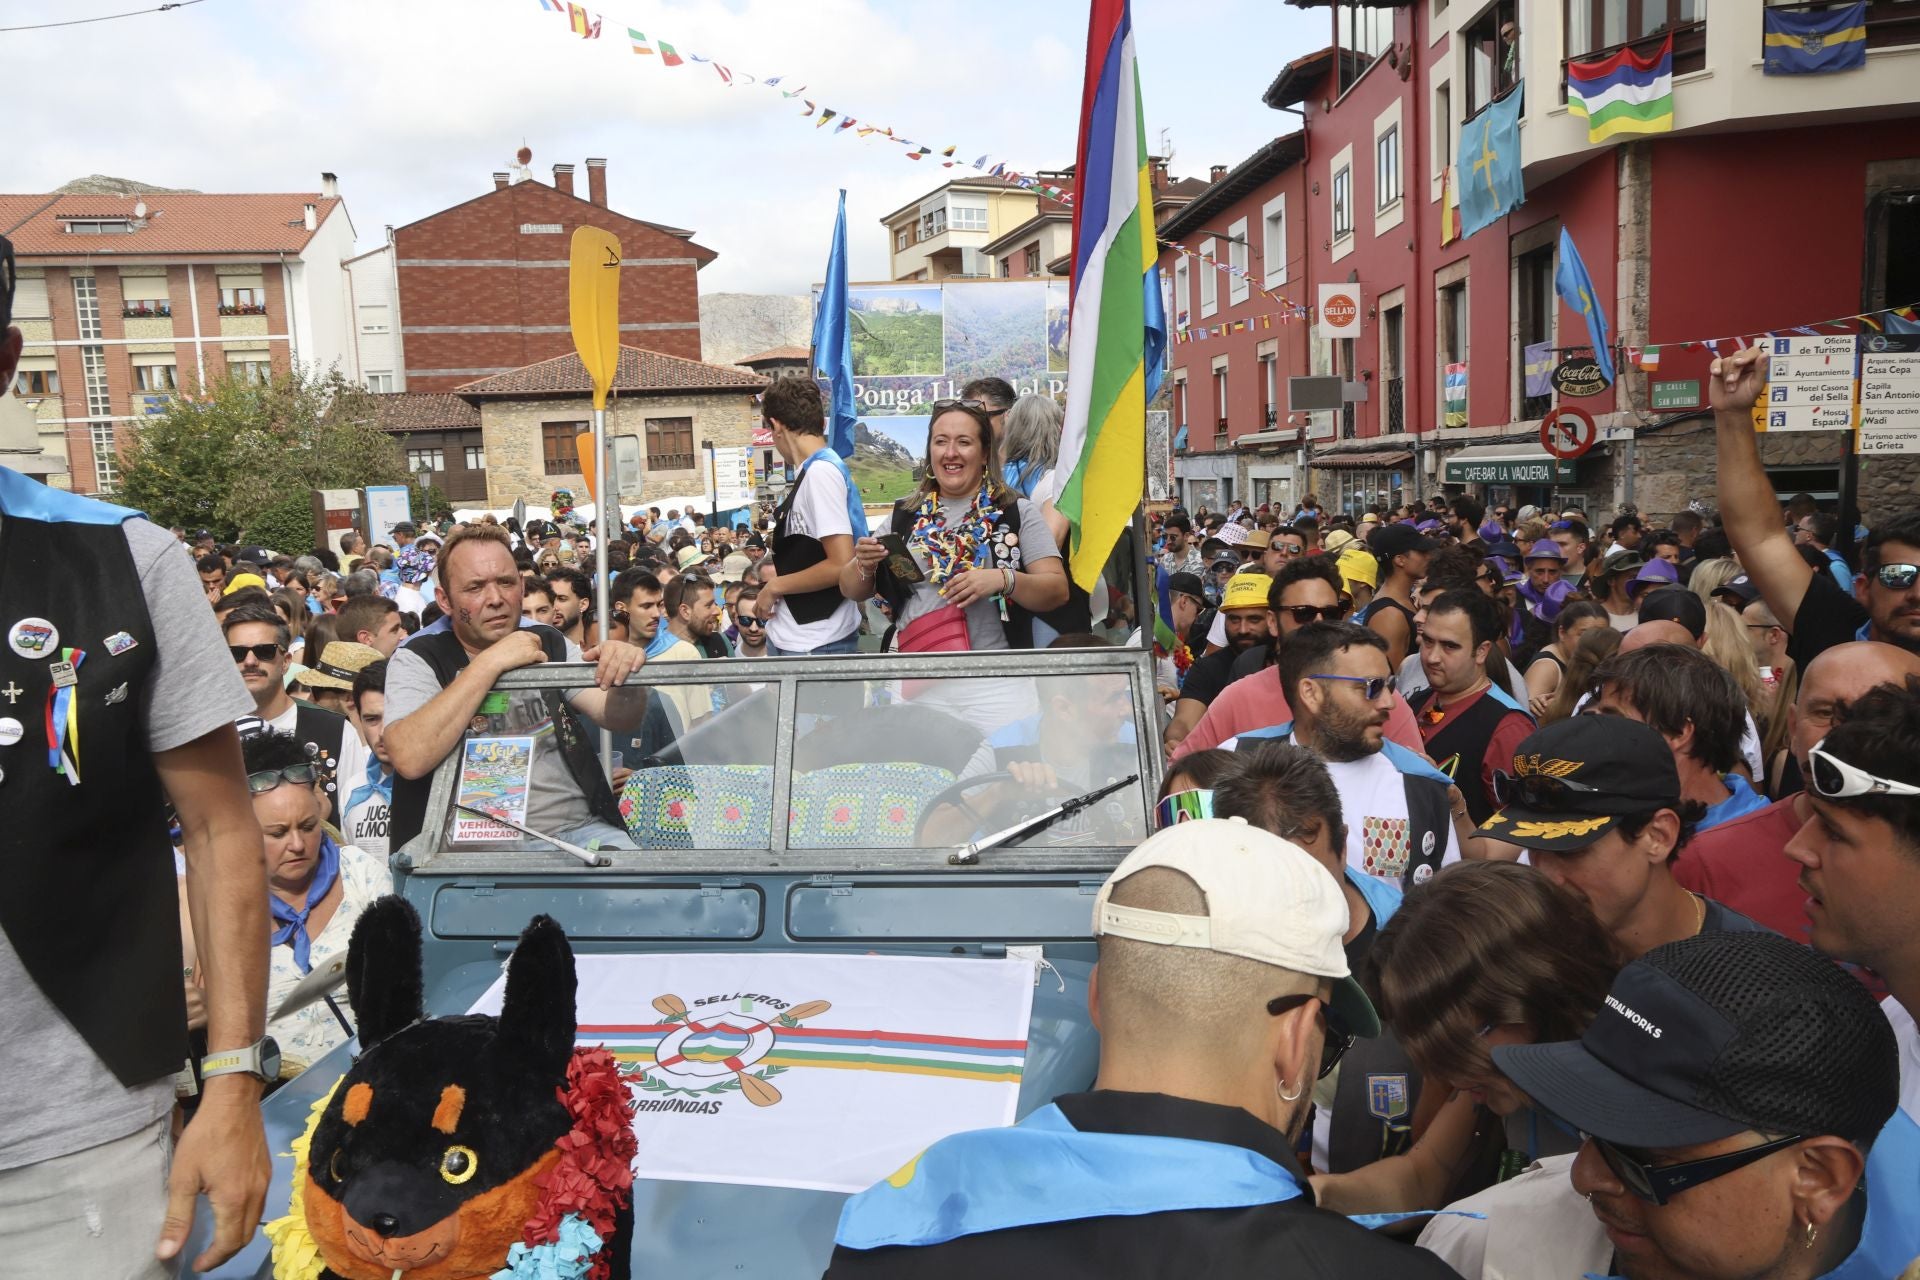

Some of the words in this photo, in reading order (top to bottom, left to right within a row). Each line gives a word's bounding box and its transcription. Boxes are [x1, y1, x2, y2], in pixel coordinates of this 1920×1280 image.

[1824, 337, 1852, 345] Oficina
[1799, 347, 1811, 355] de
[1814, 345, 1851, 354] Turismo
[1795, 369, 1850, 378] Ayuntamiento
[1867, 366, 1887, 374] Casa
[1889, 366, 1911, 375] Cepa
[853, 383, 923, 413] Ponga
[1809, 394, 1824, 402] del
[1826, 393, 1849, 401] Sella
[1865, 392, 1882, 400] San
[1884, 391, 1920, 399] Antonio
[1812, 418, 1848, 428] Español
[1865, 417, 1887, 425] Wadi
[1863, 442, 1874, 450] La
[1876, 441, 1904, 450] Grieta
[1498, 466, 1508, 480] LA
[1511, 465, 1550, 481] VAQUERIA
[458, 820, 520, 830] VEHICU
[355, 822, 364, 838] EL
[457, 830, 520, 839] AUTORIZADO
[628, 1097, 723, 1115] ARRIONDAS
